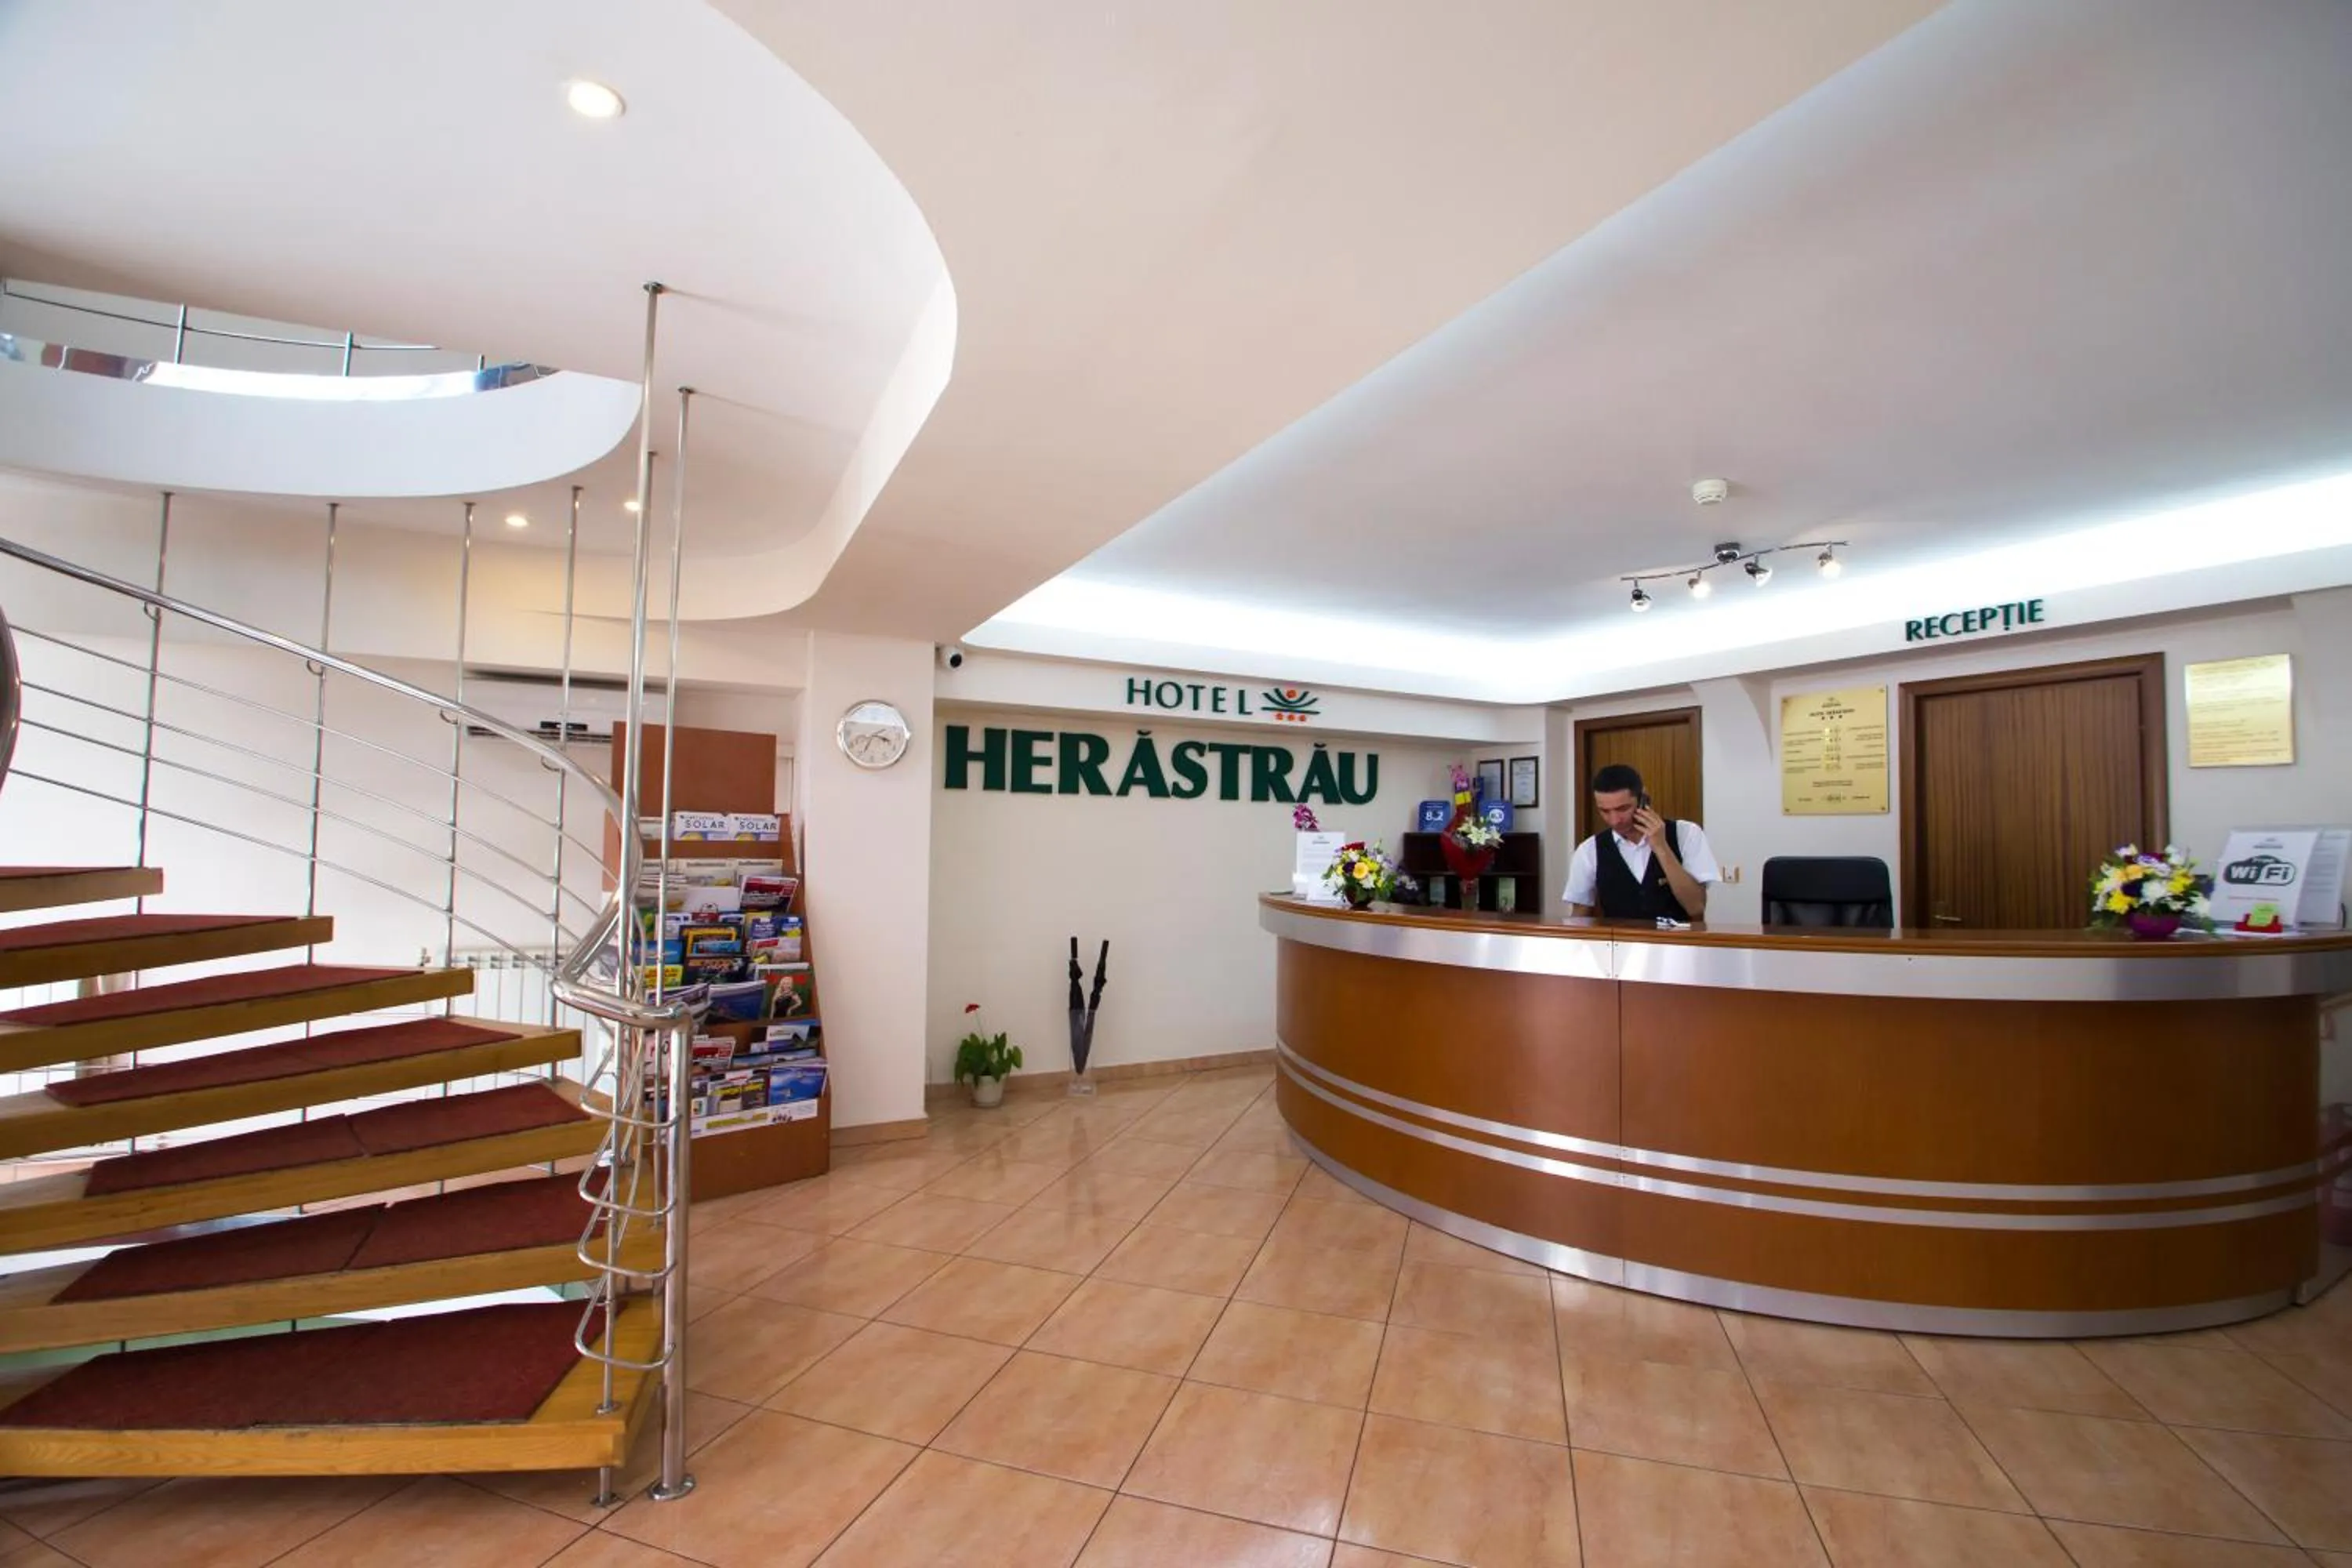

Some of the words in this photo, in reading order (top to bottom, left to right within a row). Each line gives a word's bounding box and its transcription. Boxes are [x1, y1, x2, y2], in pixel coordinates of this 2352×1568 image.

[1127, 677, 1253, 715] HOTEL
[945, 724, 1379, 805] HERĂSTRĂU
[739, 821, 777, 830] SOLAR
